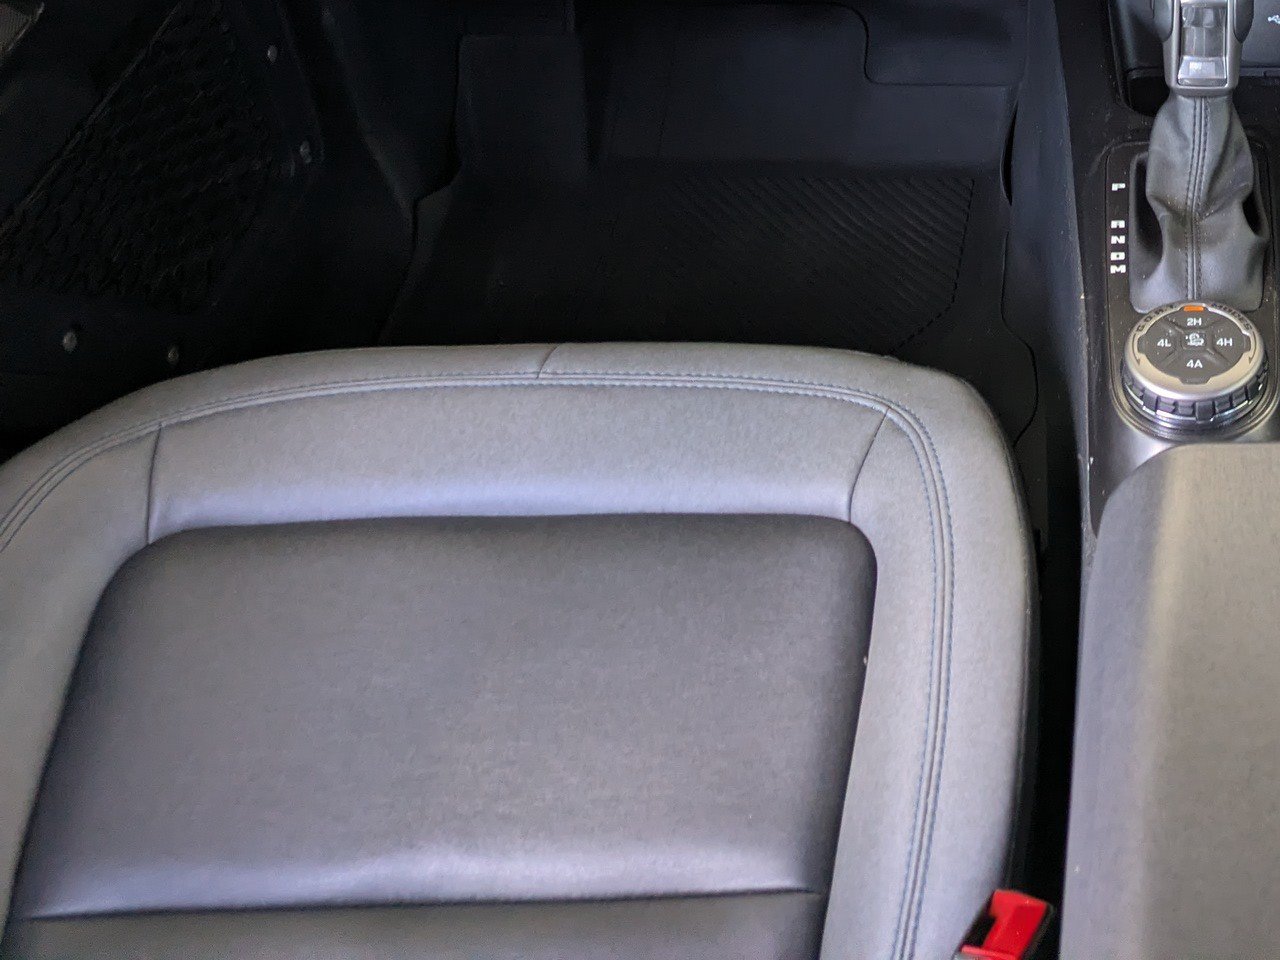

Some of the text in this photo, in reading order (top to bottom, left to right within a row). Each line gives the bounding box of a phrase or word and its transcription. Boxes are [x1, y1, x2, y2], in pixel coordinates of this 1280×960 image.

[1110, 235, 1126, 245] N
[1110, 251, 1126, 261] D
[1110, 264, 1127, 274] M
[1186, 317, 1202, 326] 2H
[1156, 338, 1172, 348] 4L
[1216, 337, 1233, 347] 4H
[1186, 359, 1204, 369] 4A
